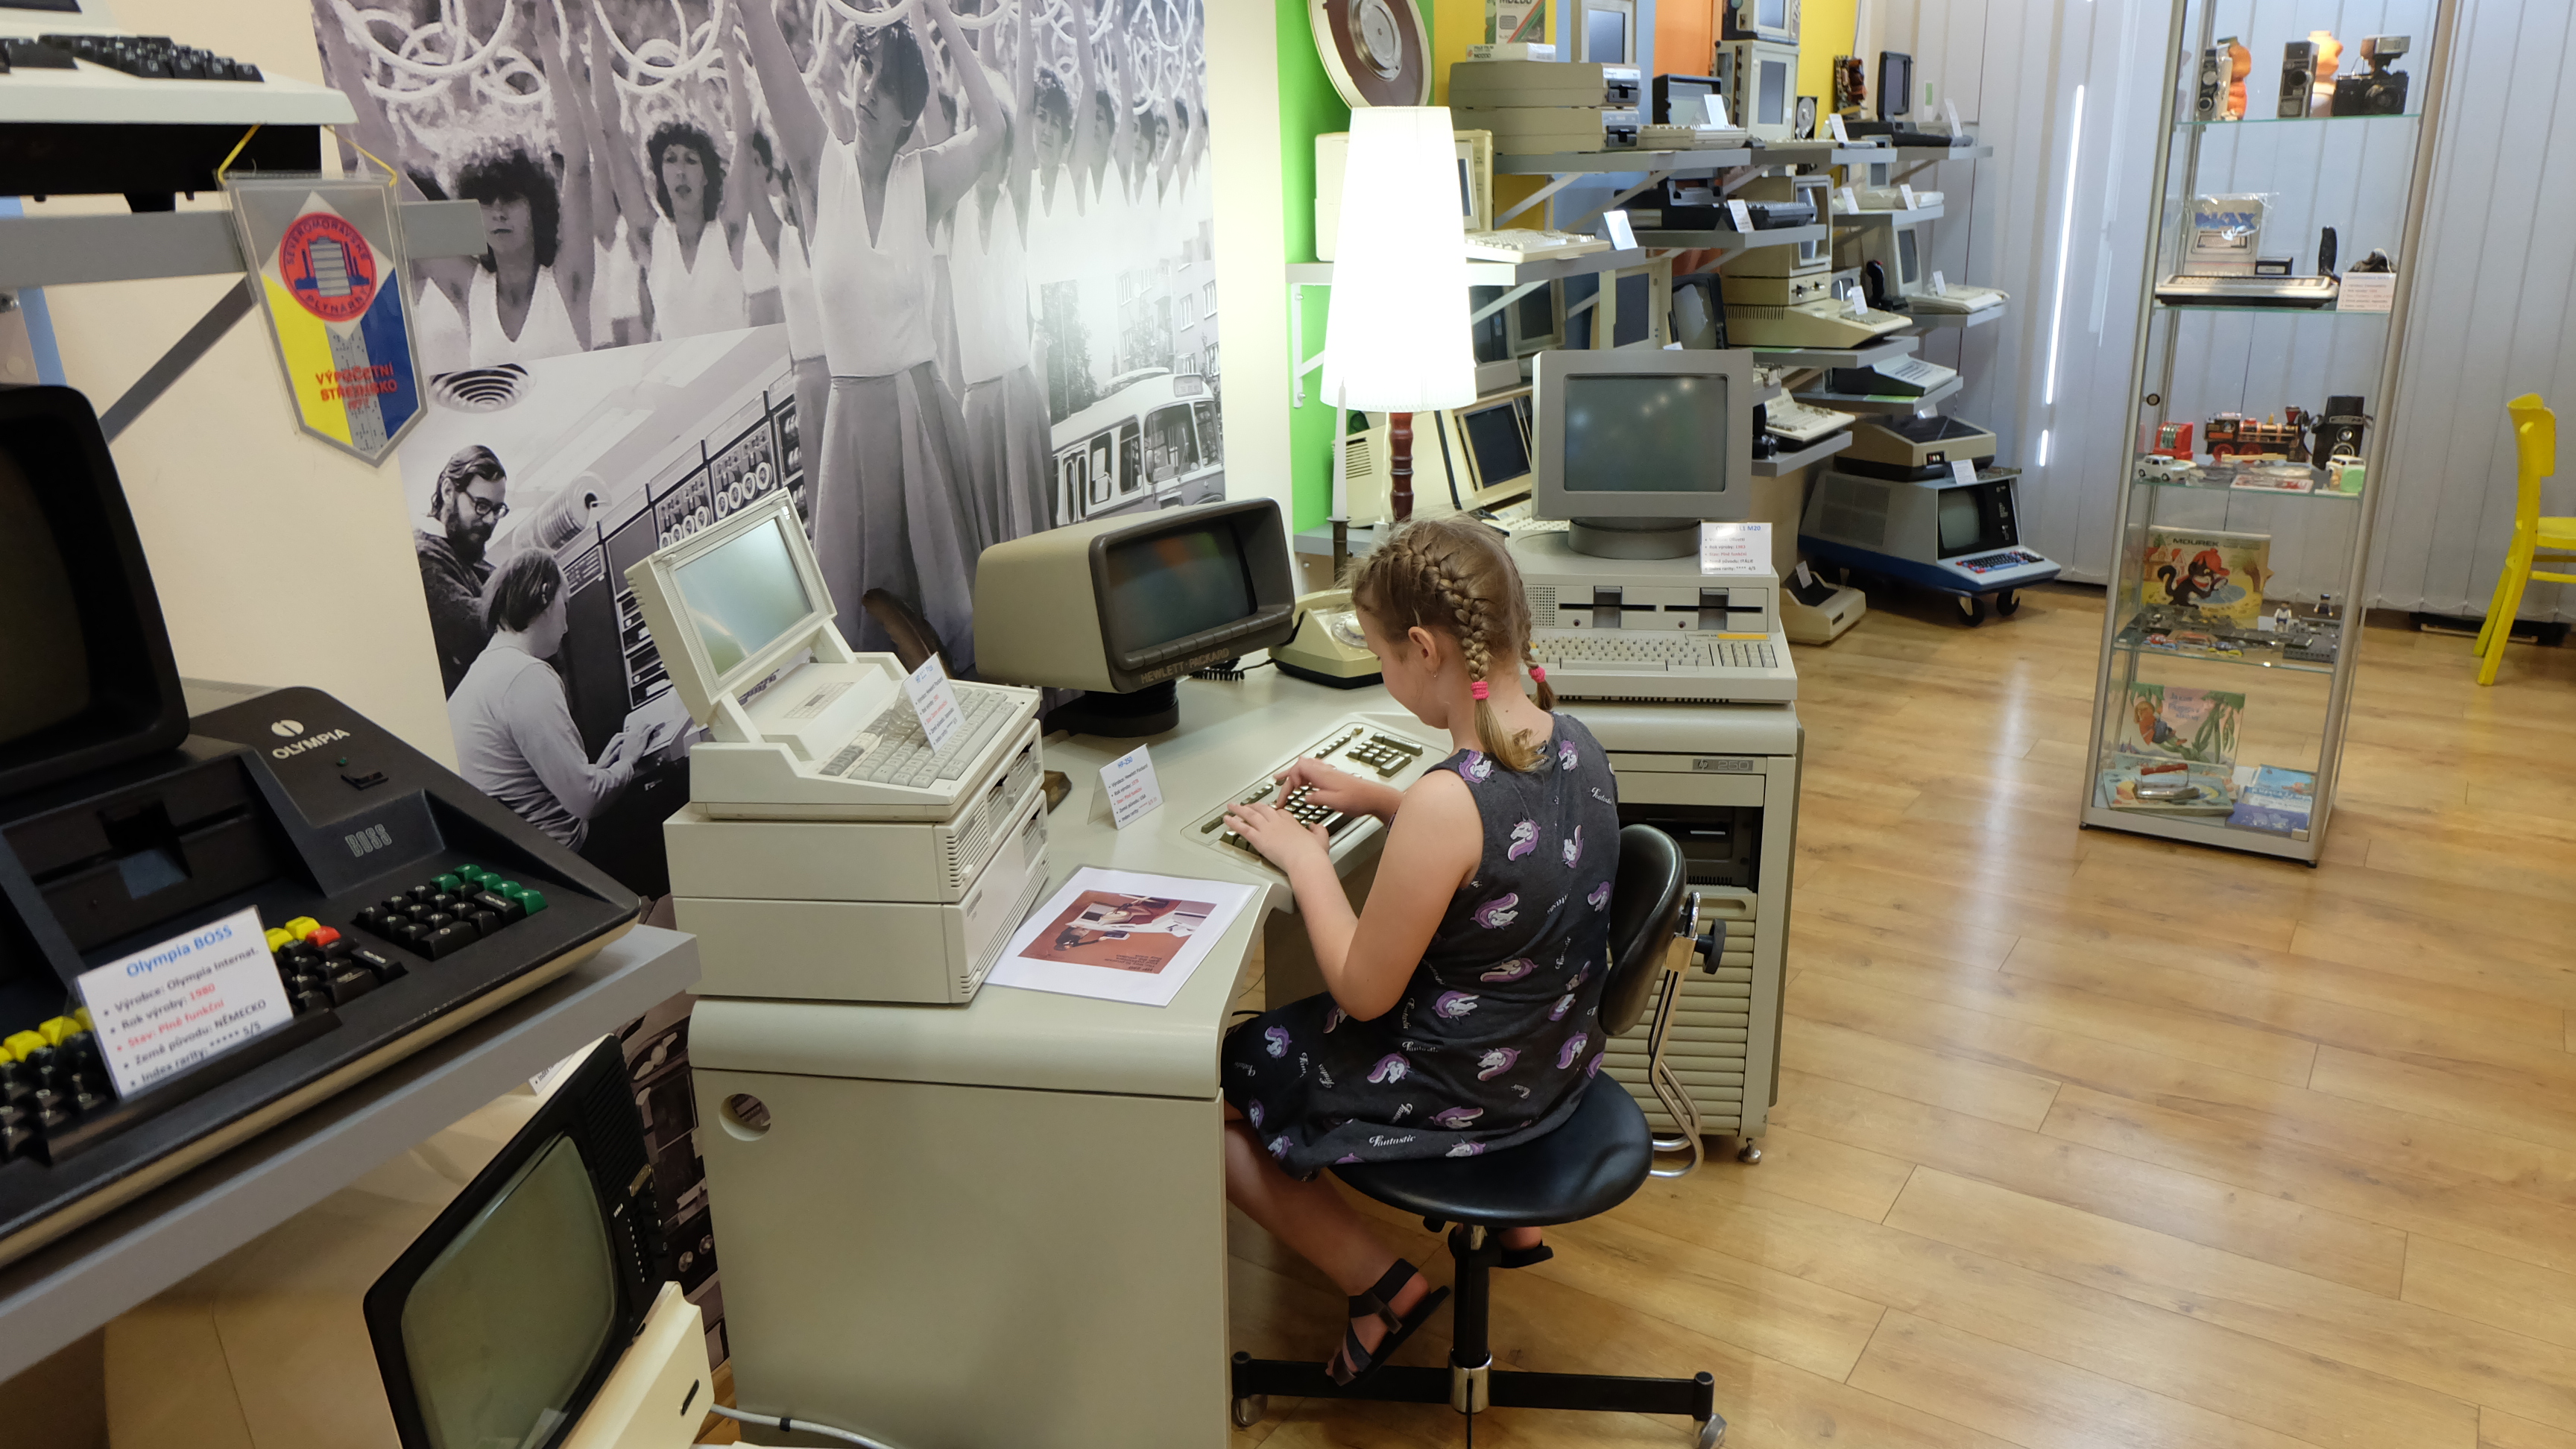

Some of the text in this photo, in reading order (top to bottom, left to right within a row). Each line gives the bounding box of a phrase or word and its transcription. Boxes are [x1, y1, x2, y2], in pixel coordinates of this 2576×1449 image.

[272, 728, 351, 759] OLYMPIA
[1718, 760, 1749, 770] 250
[345, 824, 392, 857] BOSS
[126, 924, 233, 978] Olympia BOSS
[114, 985, 165, 1013] Výrobce:
[166, 966, 212, 991] Olympia
[121, 983, 216, 1030] Rok výroby: 1980
[134, 999, 267, 1067] Země původu: NĚMECKO
[159, 1015, 183, 1035] Plně
[185, 997, 225, 1024] funkční
[1368, 1134, 1416, 1148] Fantastic
